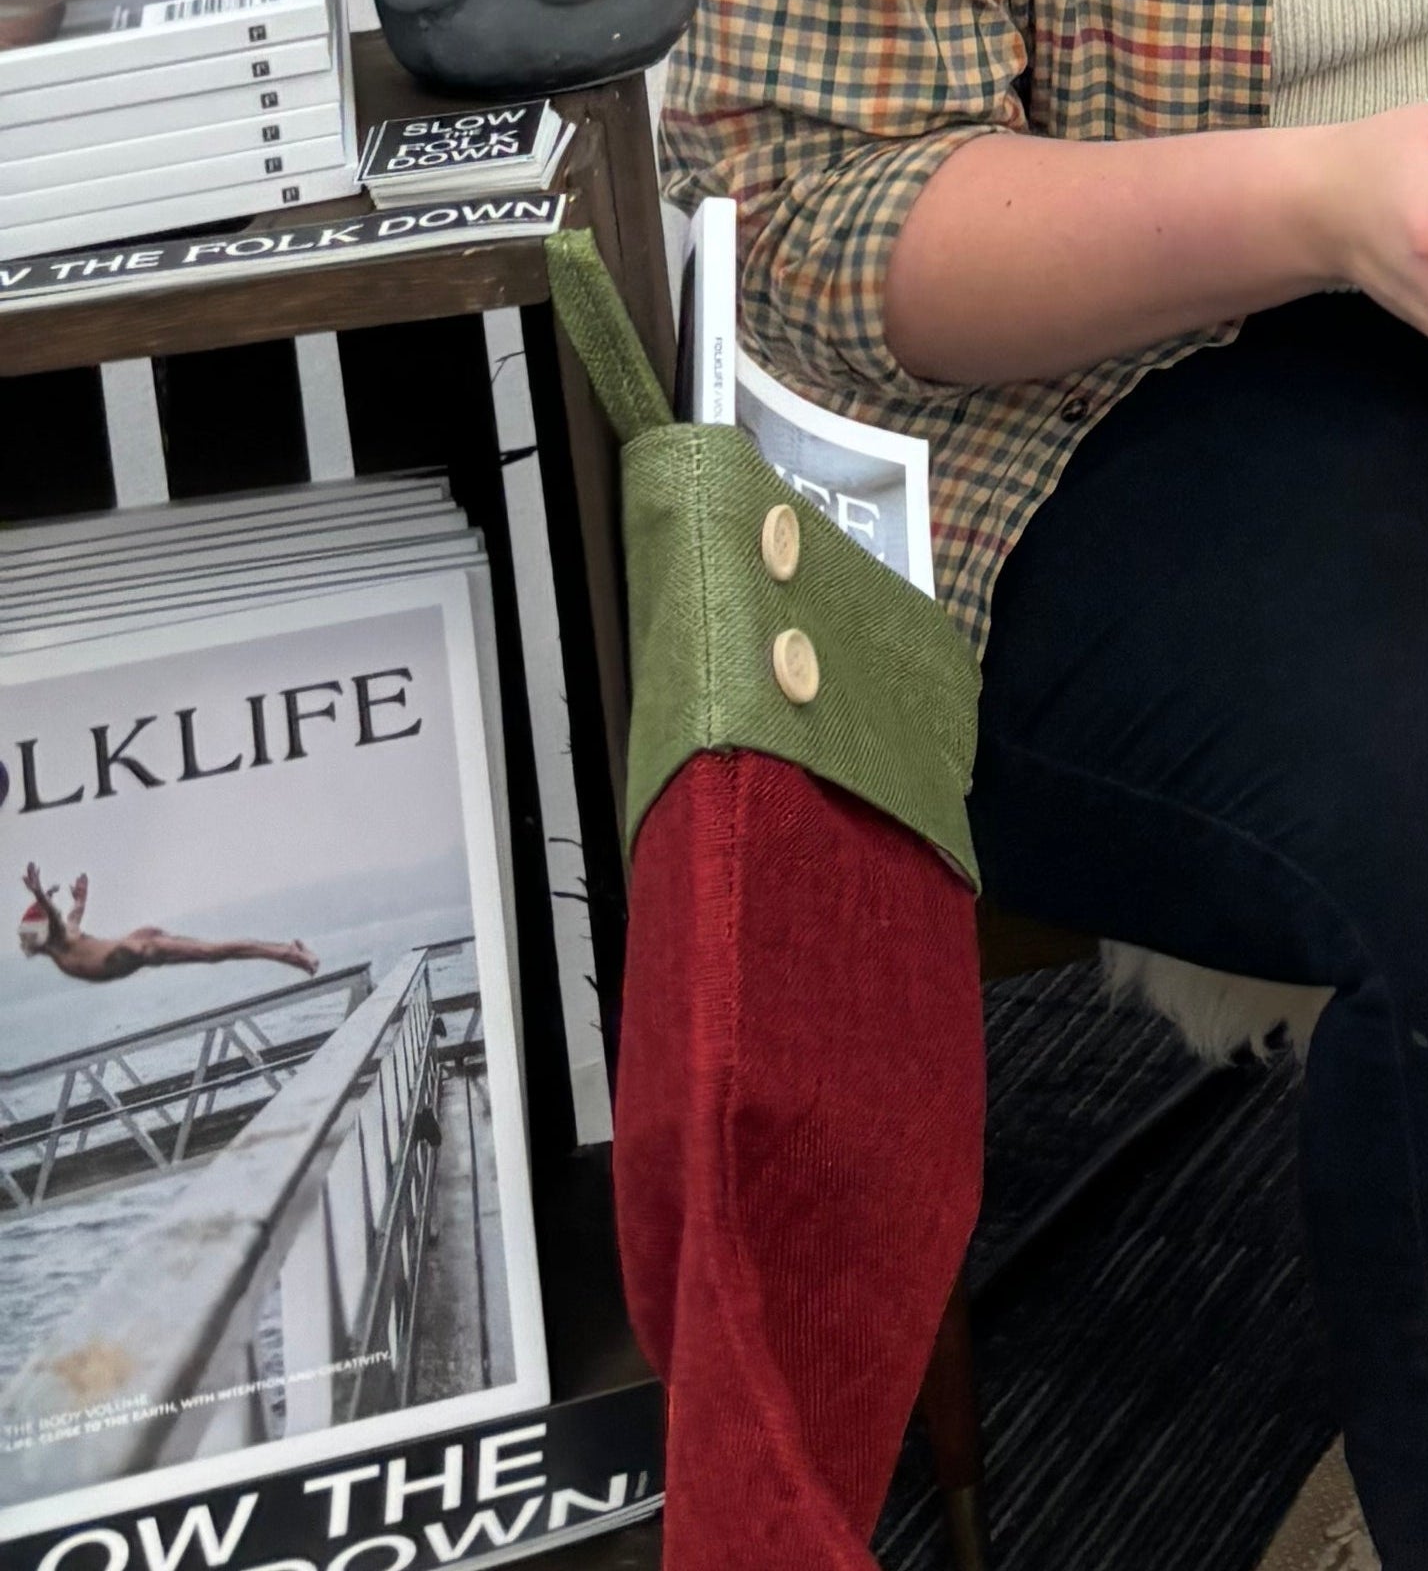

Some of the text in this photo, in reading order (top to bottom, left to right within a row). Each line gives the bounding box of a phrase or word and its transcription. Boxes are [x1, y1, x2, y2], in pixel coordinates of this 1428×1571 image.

[402, 109, 527, 136] SLOW
[444, 127, 482, 139] THE
[386, 141, 520, 171] DOWN
[396, 129, 519, 158] FOLK
[51, 250, 160, 281] THE
[183, 224, 365, 263] FOLK
[376, 200, 551, 236] DOWN
[180, 1393, 215, 1410] WITH
[304, 1423, 547, 1540] THE
